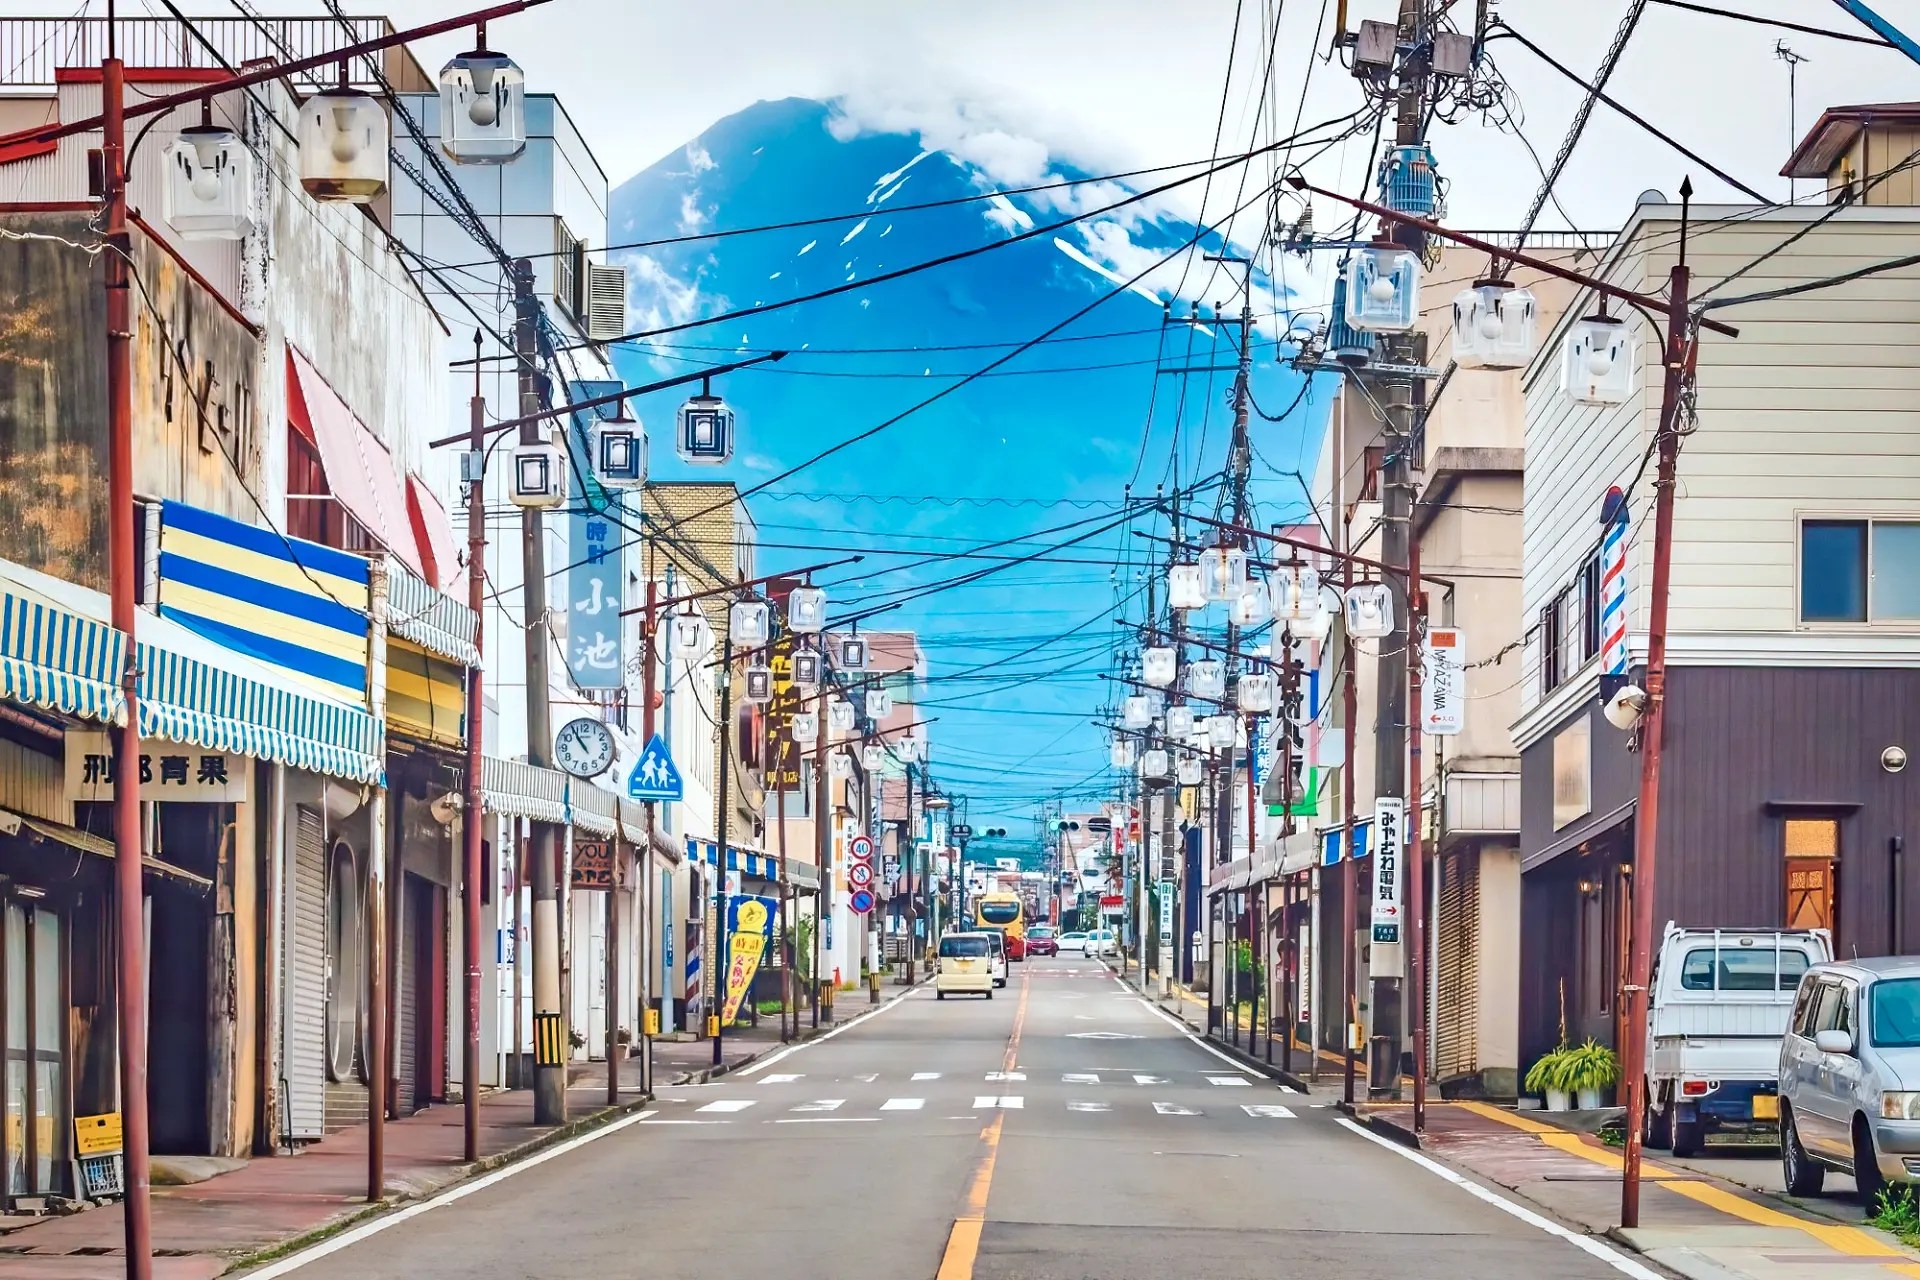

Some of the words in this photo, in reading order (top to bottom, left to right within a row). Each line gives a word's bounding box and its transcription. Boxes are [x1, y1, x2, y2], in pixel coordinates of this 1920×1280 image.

[586, 521, 608, 566] 時計
[573, 577, 619, 672] 小池
[580, 723, 590, 734] 12
[561, 733, 573, 743] 10
[598, 732, 606, 742] 2
[560, 743, 568, 753] 9
[601, 742, 609, 752] 3
[564, 752, 572, 762] 8
[598, 752, 606, 761] 4
[572, 760, 579, 769] 7
[581, 761, 589, 771] 6
[591, 760, 598, 769] 5
[573, 843, 609, 861] YOU
[855, 842, 869, 854] 40
[1379, 811, 1396, 901] みやざわ電気
